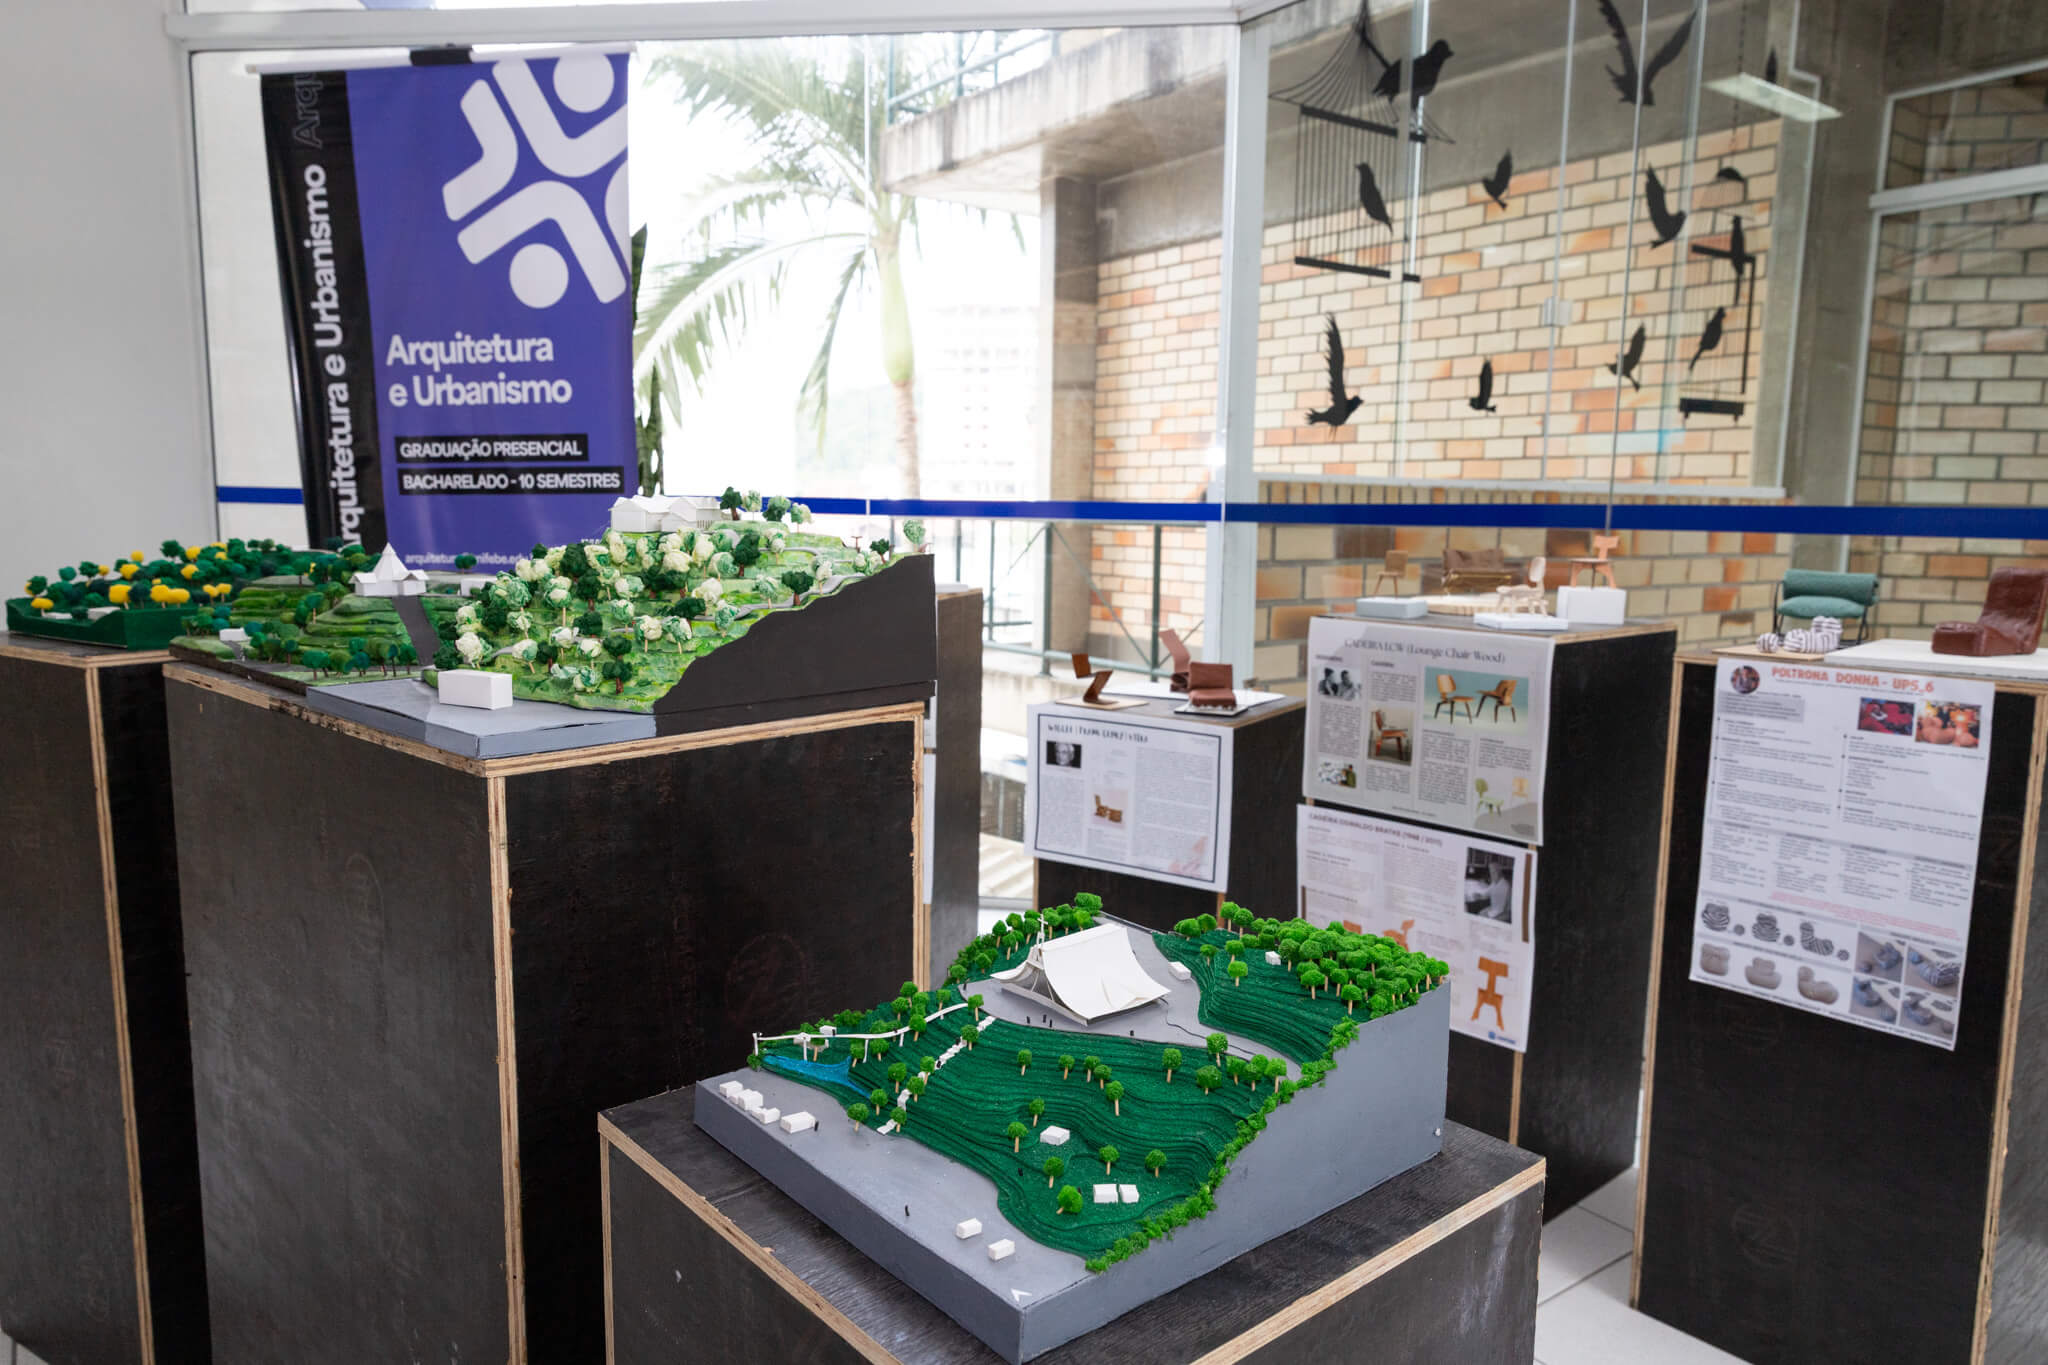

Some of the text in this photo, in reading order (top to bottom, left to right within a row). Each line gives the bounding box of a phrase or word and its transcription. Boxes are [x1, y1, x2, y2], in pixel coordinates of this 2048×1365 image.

[304, 164, 343, 347] Urbanismo
[386, 332, 554, 372] Arquitetura
[325, 354, 346, 376] e
[389, 373, 572, 407] e Urbanismo
[400, 438, 582, 461] GRADUAÇÃO PRESENCIAL
[403, 473, 509, 490] BACHARELADO
[518, 473, 533, 488] 10
[537, 472, 620, 488] SEMESTRES
[1771, 667, 1829, 681] POLTRONA
[1835, 672, 1879, 687] DONNA
